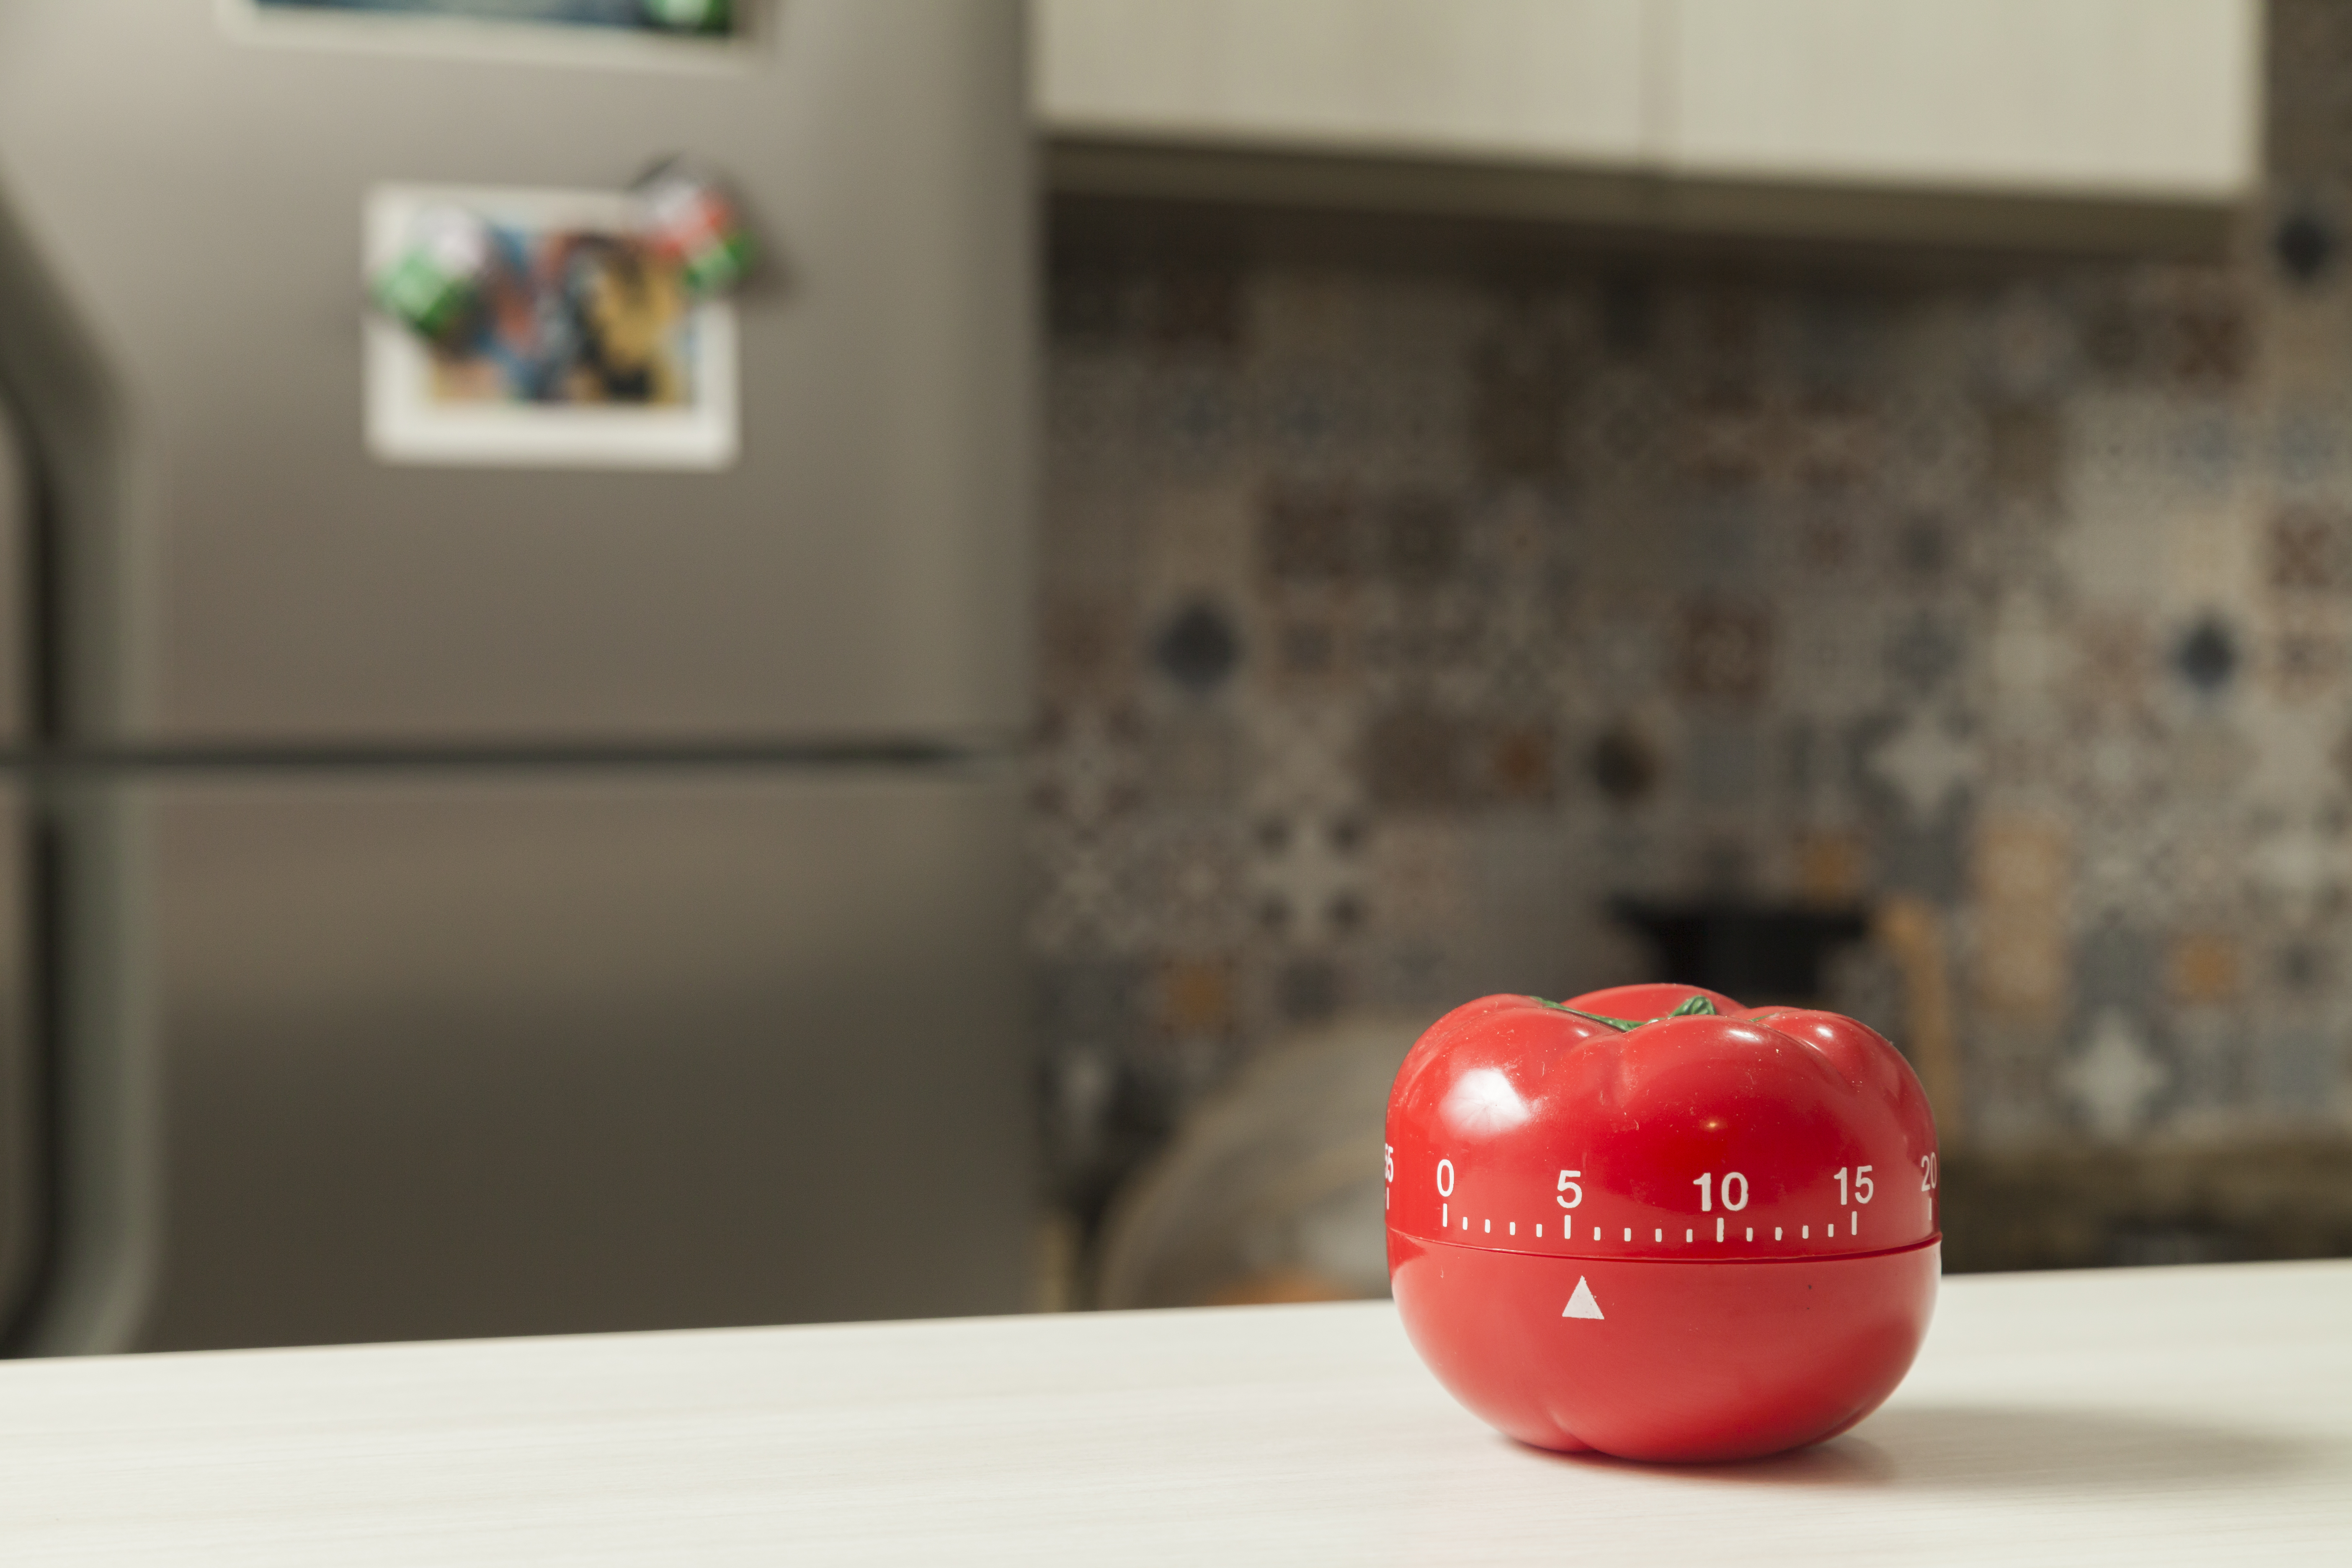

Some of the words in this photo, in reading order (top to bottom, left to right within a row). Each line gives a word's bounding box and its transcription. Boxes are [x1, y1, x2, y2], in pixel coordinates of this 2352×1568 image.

[1436, 1159, 1455, 1197] 0
[1556, 1170, 1583, 1209] 5
[1693, 1172, 1749, 1212] 10
[1834, 1165, 1874, 1205] 15
[1921, 1152, 1937, 1192] 20
